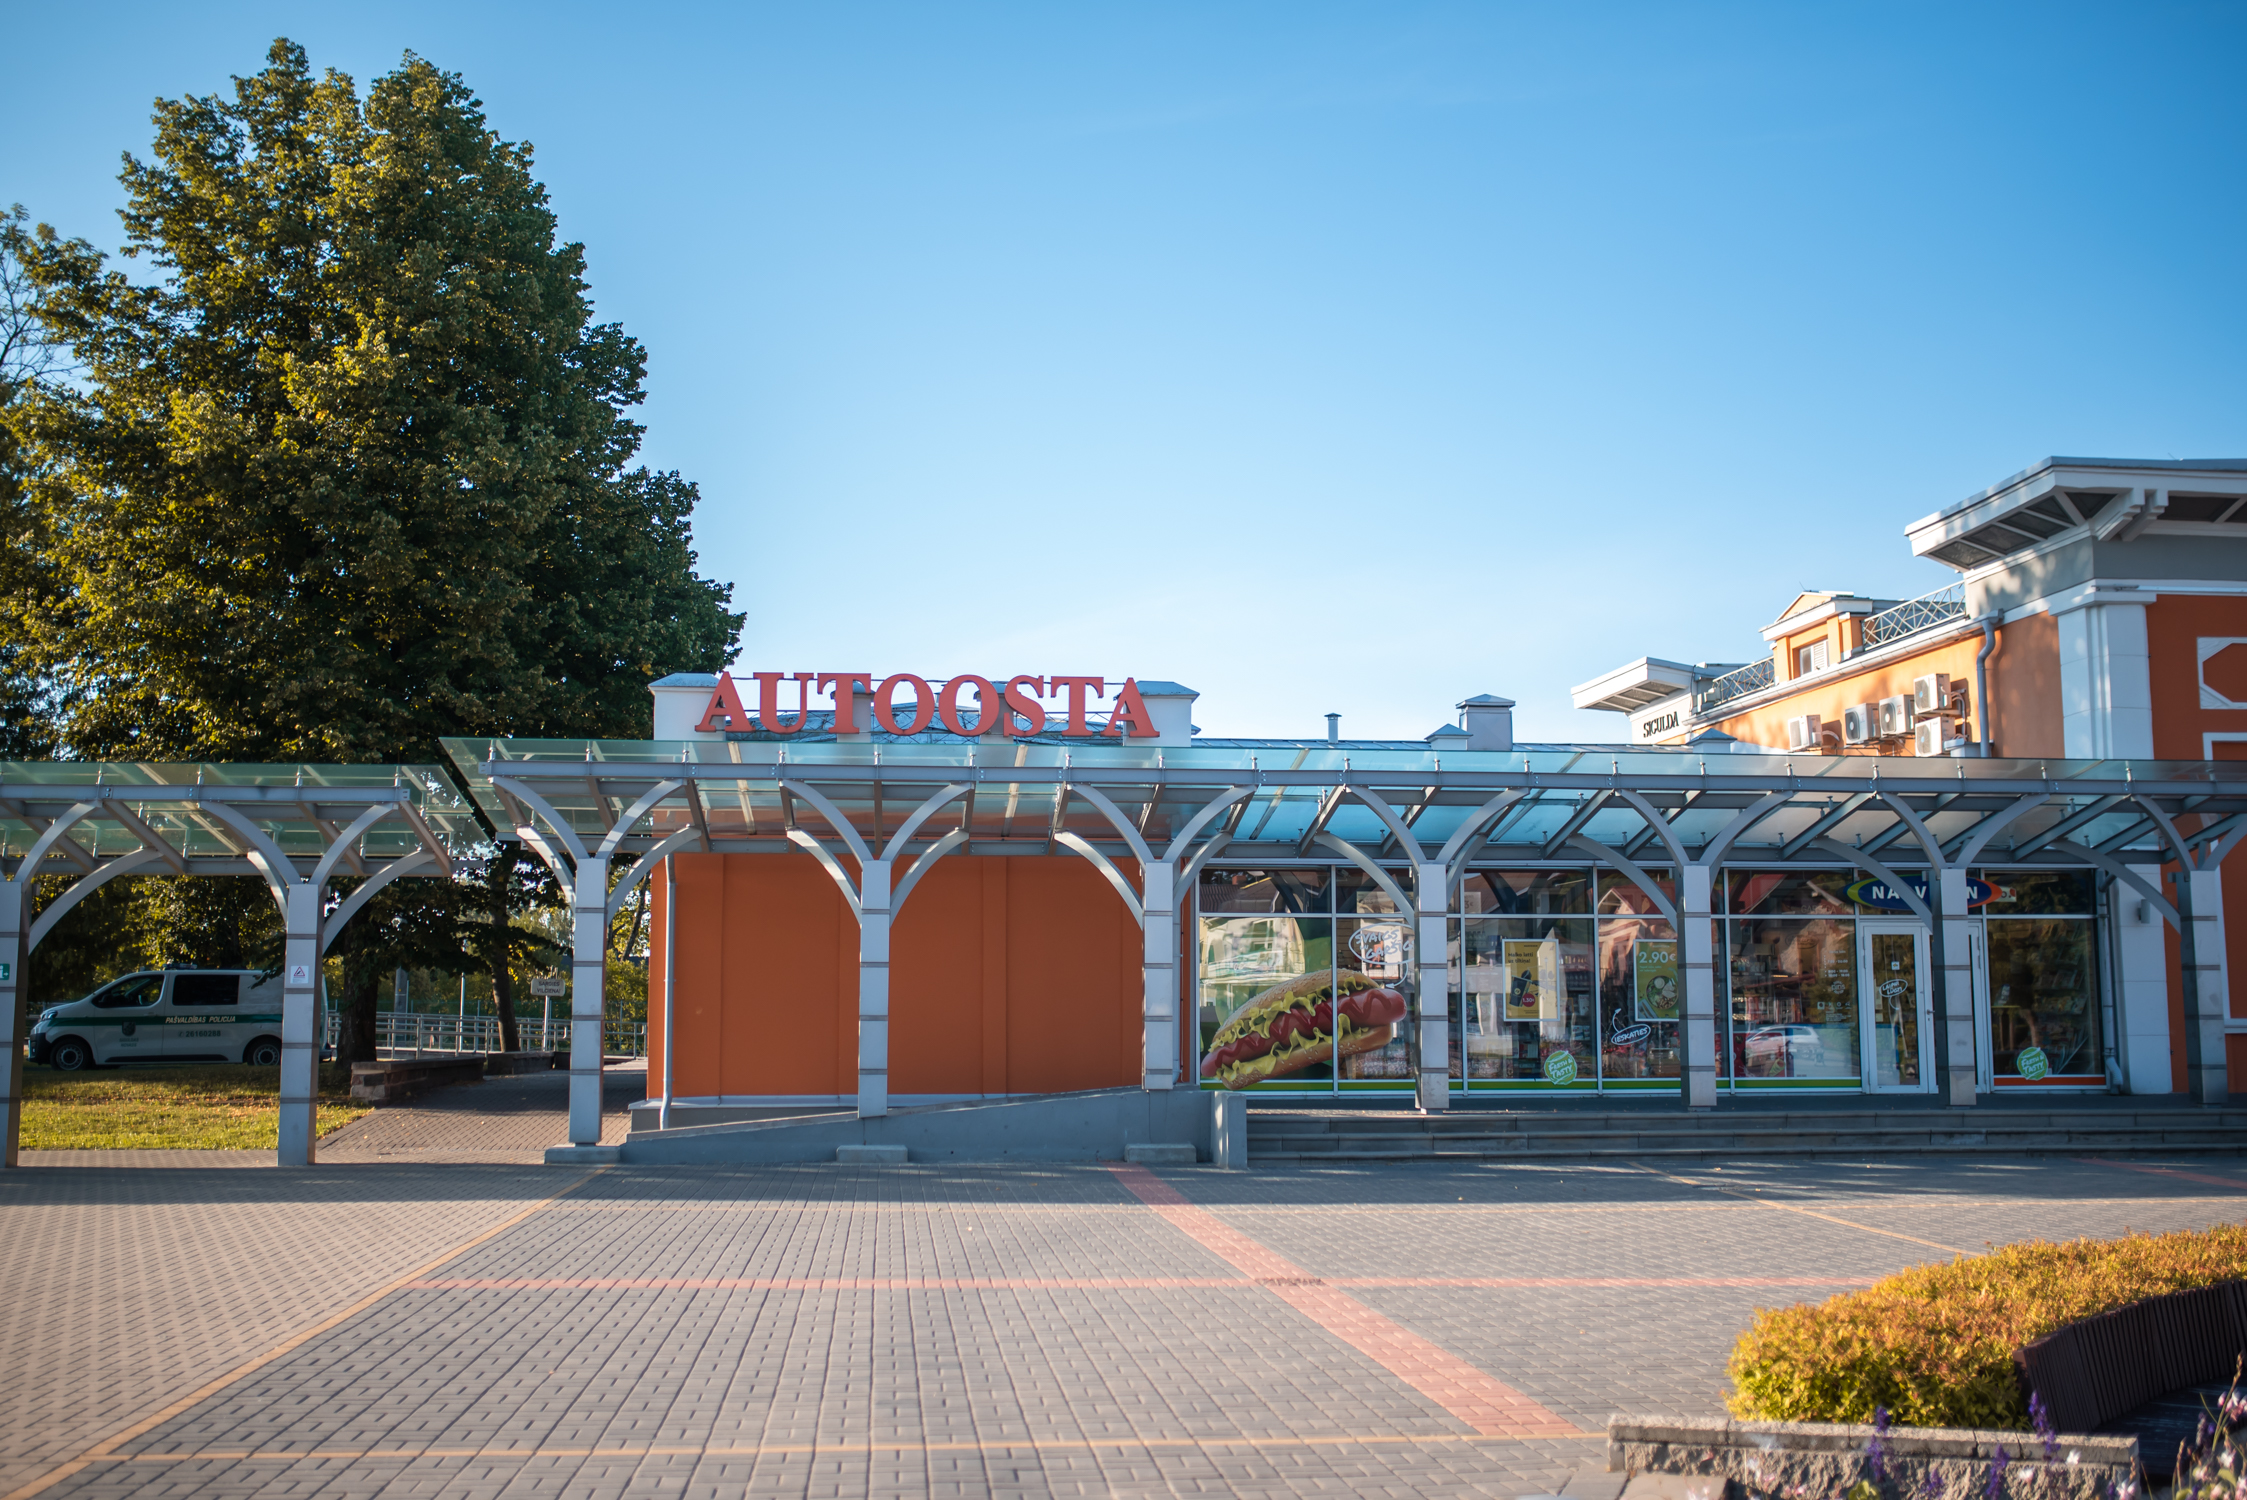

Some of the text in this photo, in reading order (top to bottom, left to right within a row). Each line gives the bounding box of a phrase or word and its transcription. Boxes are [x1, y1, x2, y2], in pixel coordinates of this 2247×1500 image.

[694, 671, 1160, 738] AUTOOSTA
[1643, 711, 1679, 738] SIGULDA
[1355, 929, 1399, 944] SVAIGS
[165, 1015, 206, 1024] PAŠVALDĪBAS
[1614, 1027, 1648, 1043] IESKATIES
[1551, 1064, 1572, 1079] TASTY
[2023, 1061, 2044, 1074] TASTY
